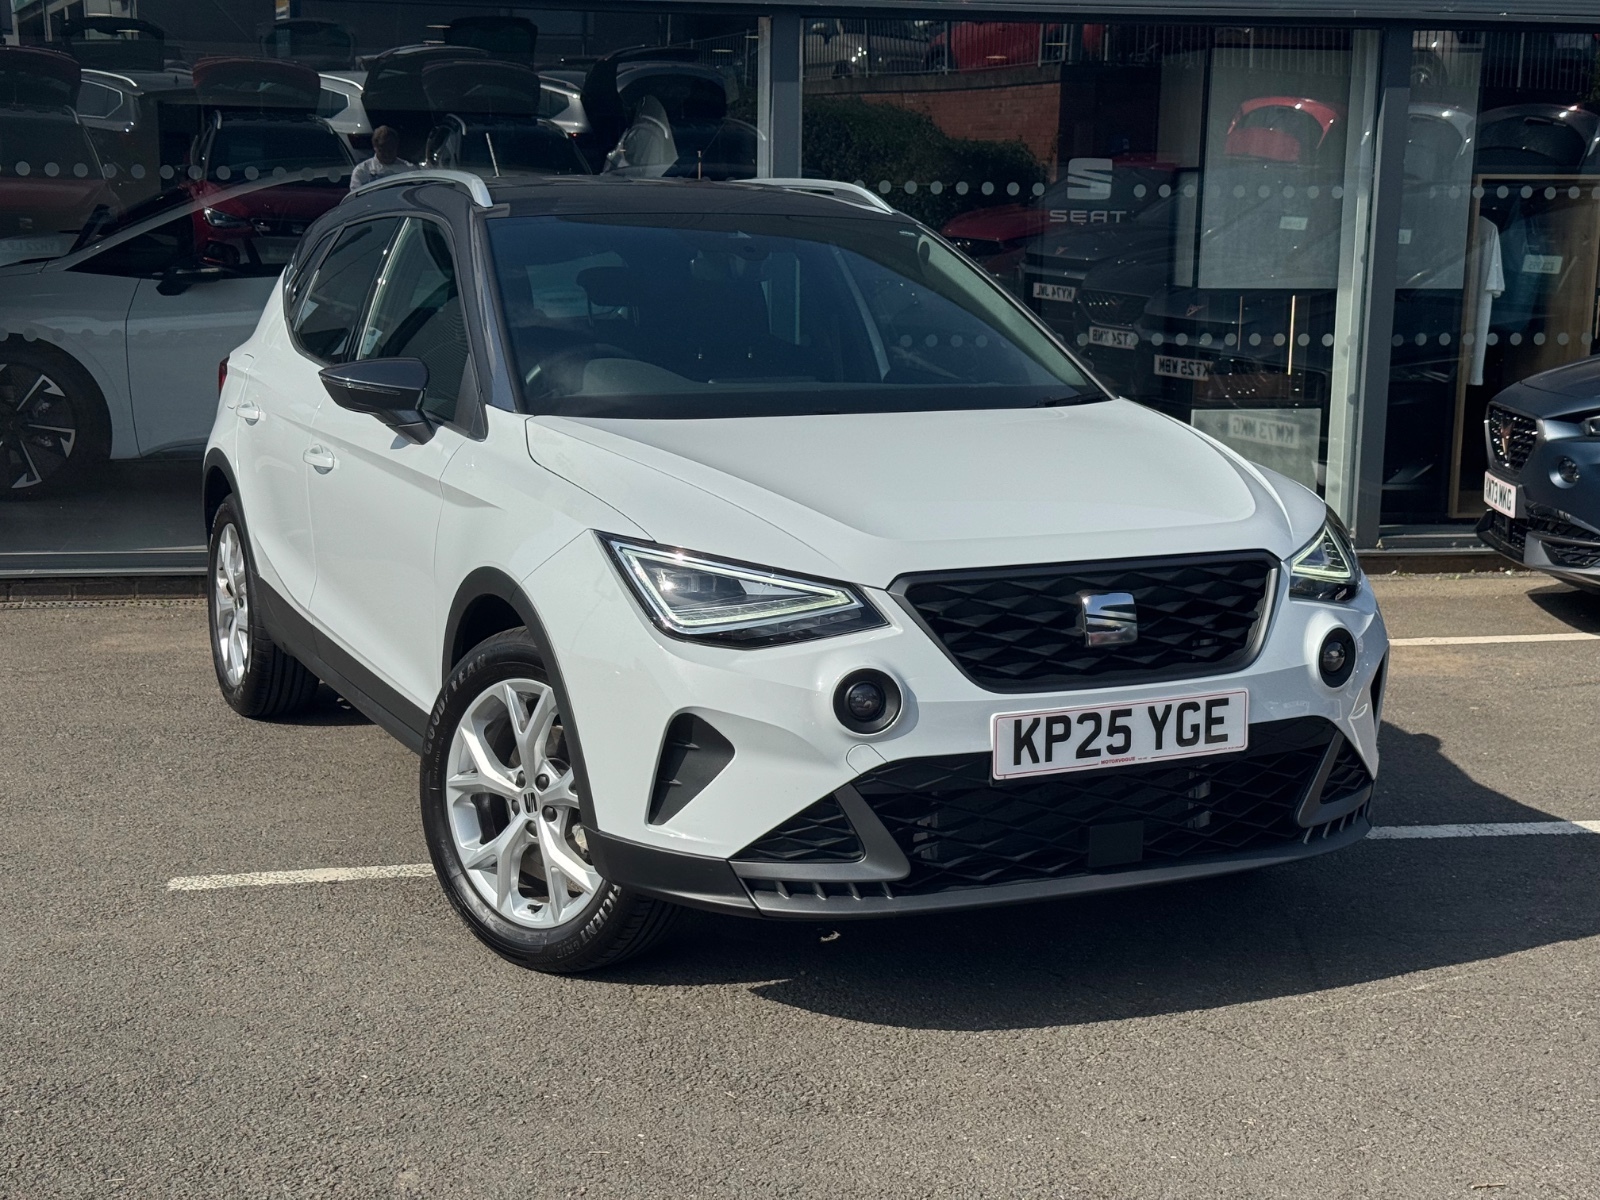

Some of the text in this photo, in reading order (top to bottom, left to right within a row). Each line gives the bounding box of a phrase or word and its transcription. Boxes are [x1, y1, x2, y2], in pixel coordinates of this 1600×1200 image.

[1049, 210, 1127, 223] SEAT
[423, 698, 446, 755] GOOD
[1013, 698, 1230, 766] KP25 YGE
